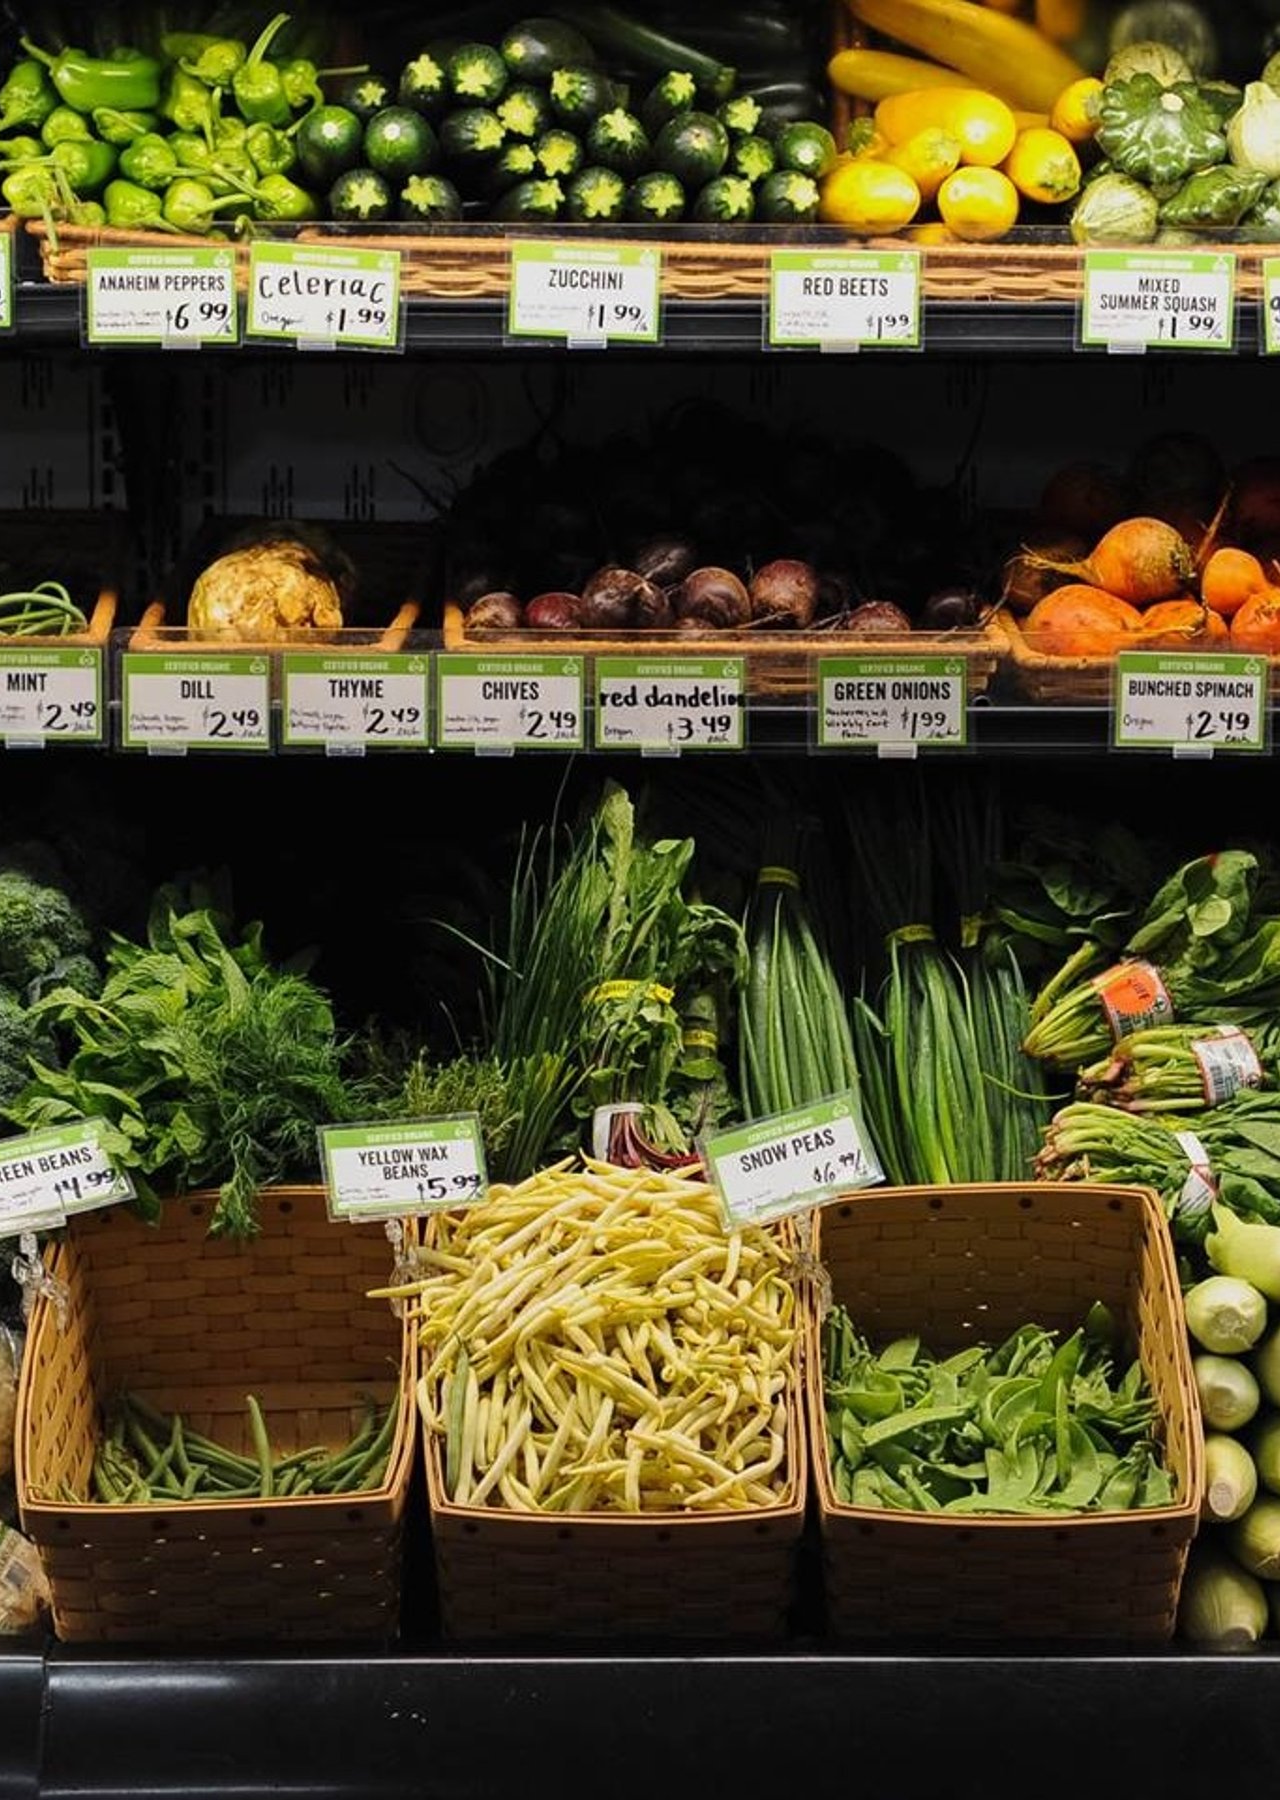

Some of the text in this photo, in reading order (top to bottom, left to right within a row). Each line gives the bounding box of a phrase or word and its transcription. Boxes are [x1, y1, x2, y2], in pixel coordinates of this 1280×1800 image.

[99, 274, 226, 292] ANAHEIM PEPPERS
[549, 269, 624, 290] ZUCCHINI
[803, 277, 888, 297] RED BEETS
[1138, 278, 1180, 293] MIXED
[1100, 294, 1217, 313] SUMMER SQUASH
[7, 672, 47, 692] MINT
[180, 680, 215, 700] DILL
[328, 679, 384, 699] THYME
[481, 681, 539, 701] CHIVES
[834, 681, 951, 701] GREEN ONIONS
[1128, 680, 1254, 699] BUNCHED SPINACH
[600, 685, 637, 708] red
[40, 1147, 93, 1173] BEANS
[358, 1146, 449, 1166] YELLOW WAX
[739, 1143, 788, 1173] SNOW
[791, 1128, 836, 1156] PEAS
[382, 1164, 430, 1181] BEANS
